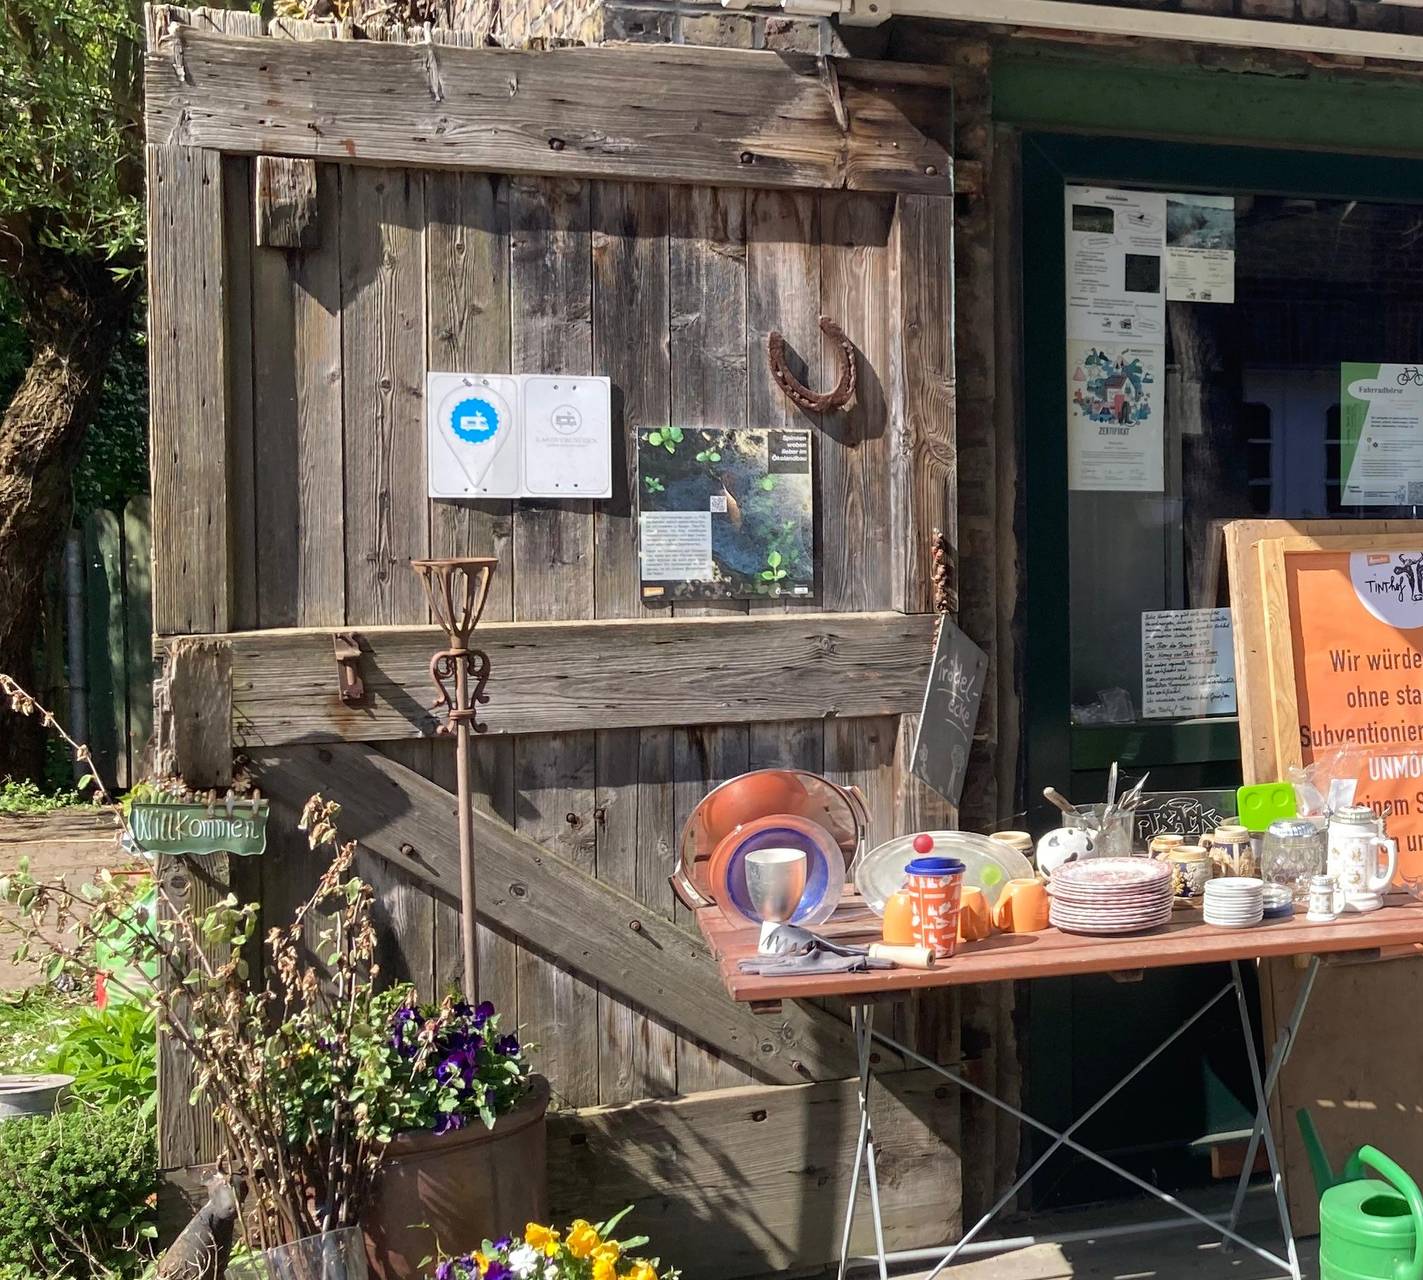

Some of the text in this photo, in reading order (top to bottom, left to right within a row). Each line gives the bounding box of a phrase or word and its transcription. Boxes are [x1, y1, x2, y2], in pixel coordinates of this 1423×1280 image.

[1329, 650, 1360, 672] Wir
[1346, 686, 1389, 708] ohne
[135, 808, 260, 841] Willkommen
